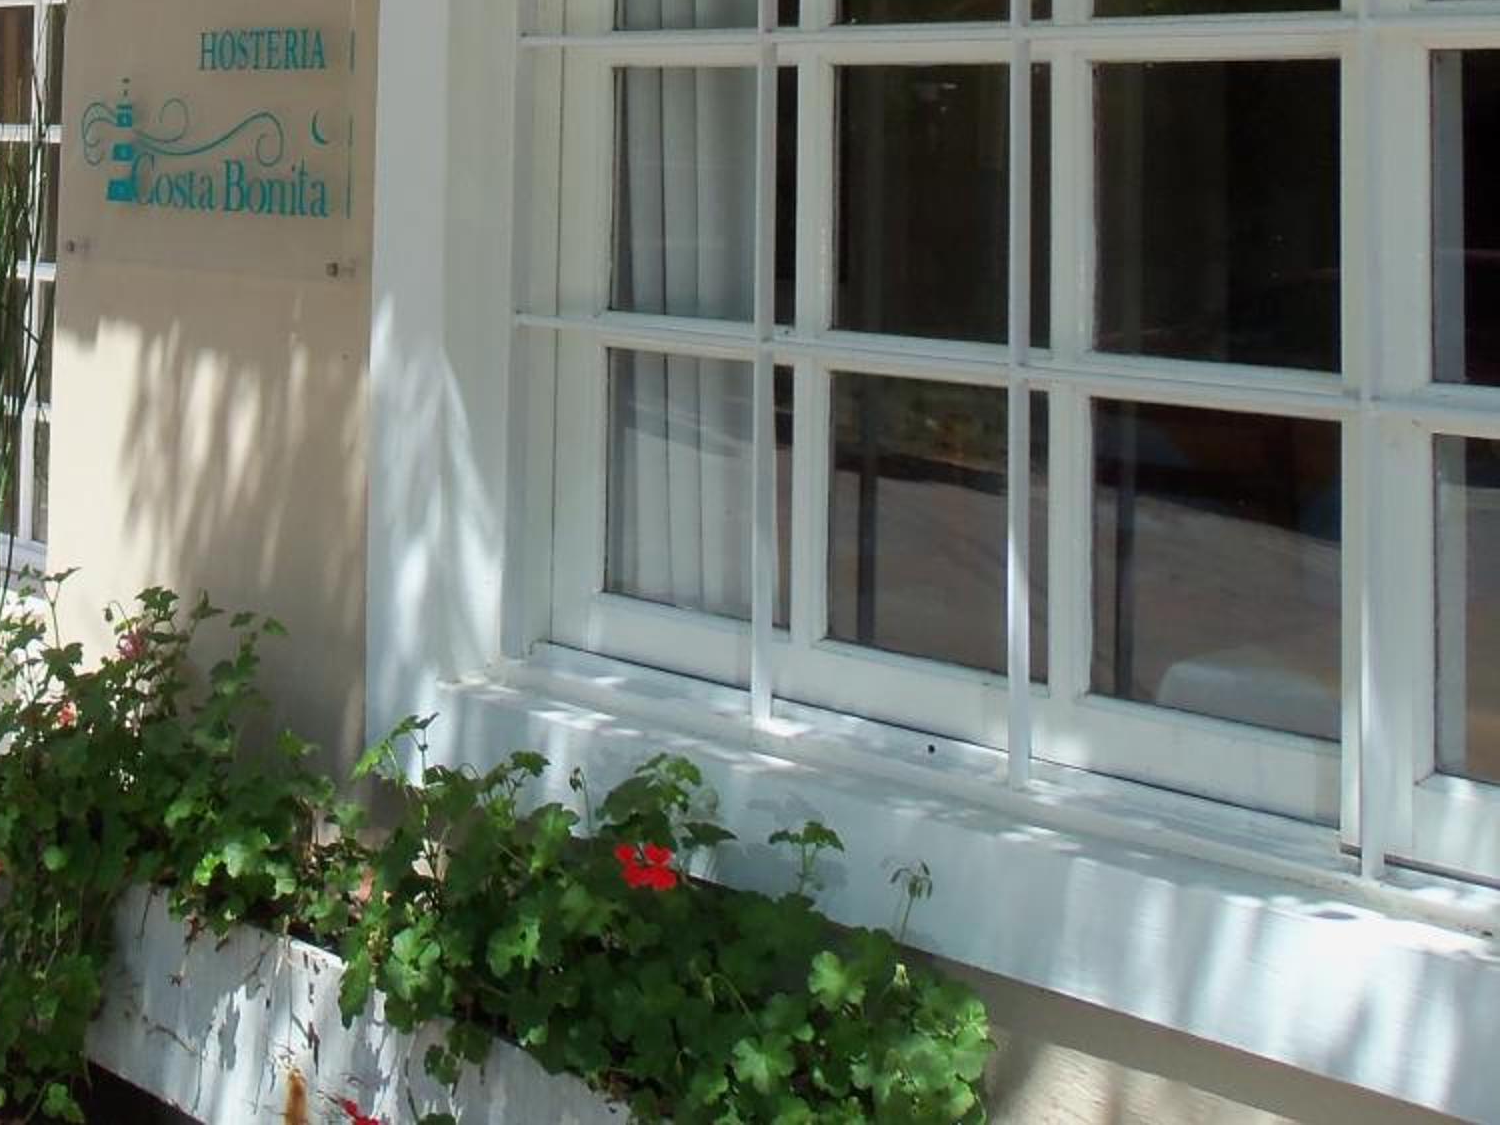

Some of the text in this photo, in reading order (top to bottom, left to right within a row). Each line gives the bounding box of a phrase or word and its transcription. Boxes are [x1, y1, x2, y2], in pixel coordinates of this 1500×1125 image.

[199, 27, 326, 70] HOSTERIA
[132, 153, 329, 218] Costa Bonita
